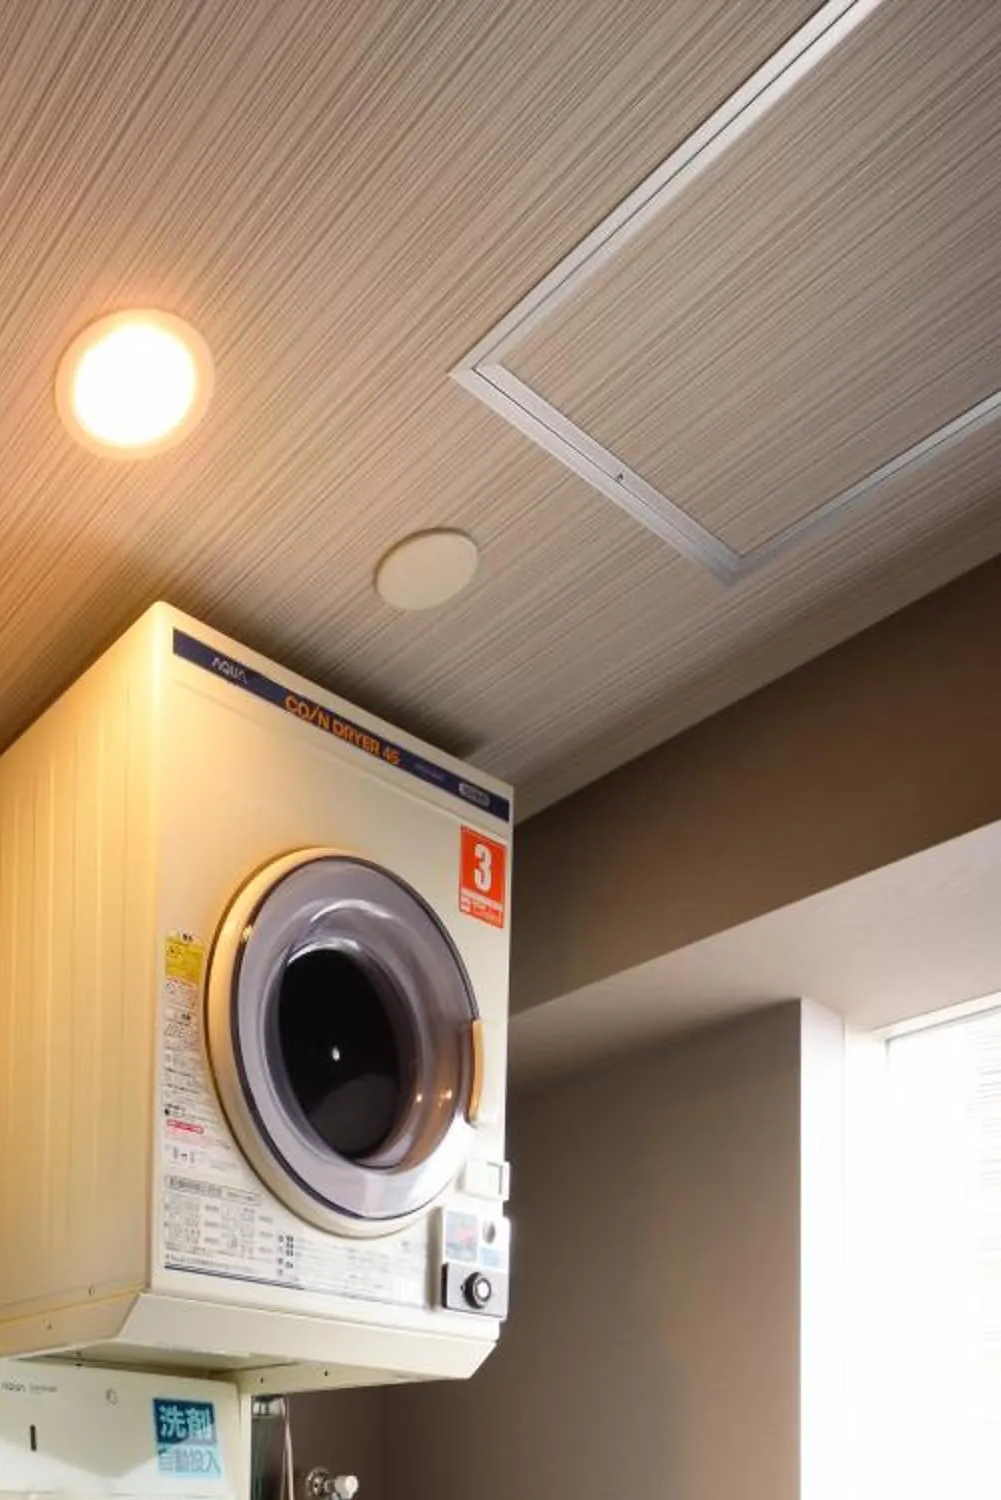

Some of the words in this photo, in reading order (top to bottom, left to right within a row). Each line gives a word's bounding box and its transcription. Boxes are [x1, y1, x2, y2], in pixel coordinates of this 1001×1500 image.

[212, 656, 248, 684] AQUA
[332, 720, 380, 757] DRYER
[473, 842, 493, 891] 3
[159, 1403, 213, 1441] 洗剤
[157, 1447, 221, 1475] 自動投入
